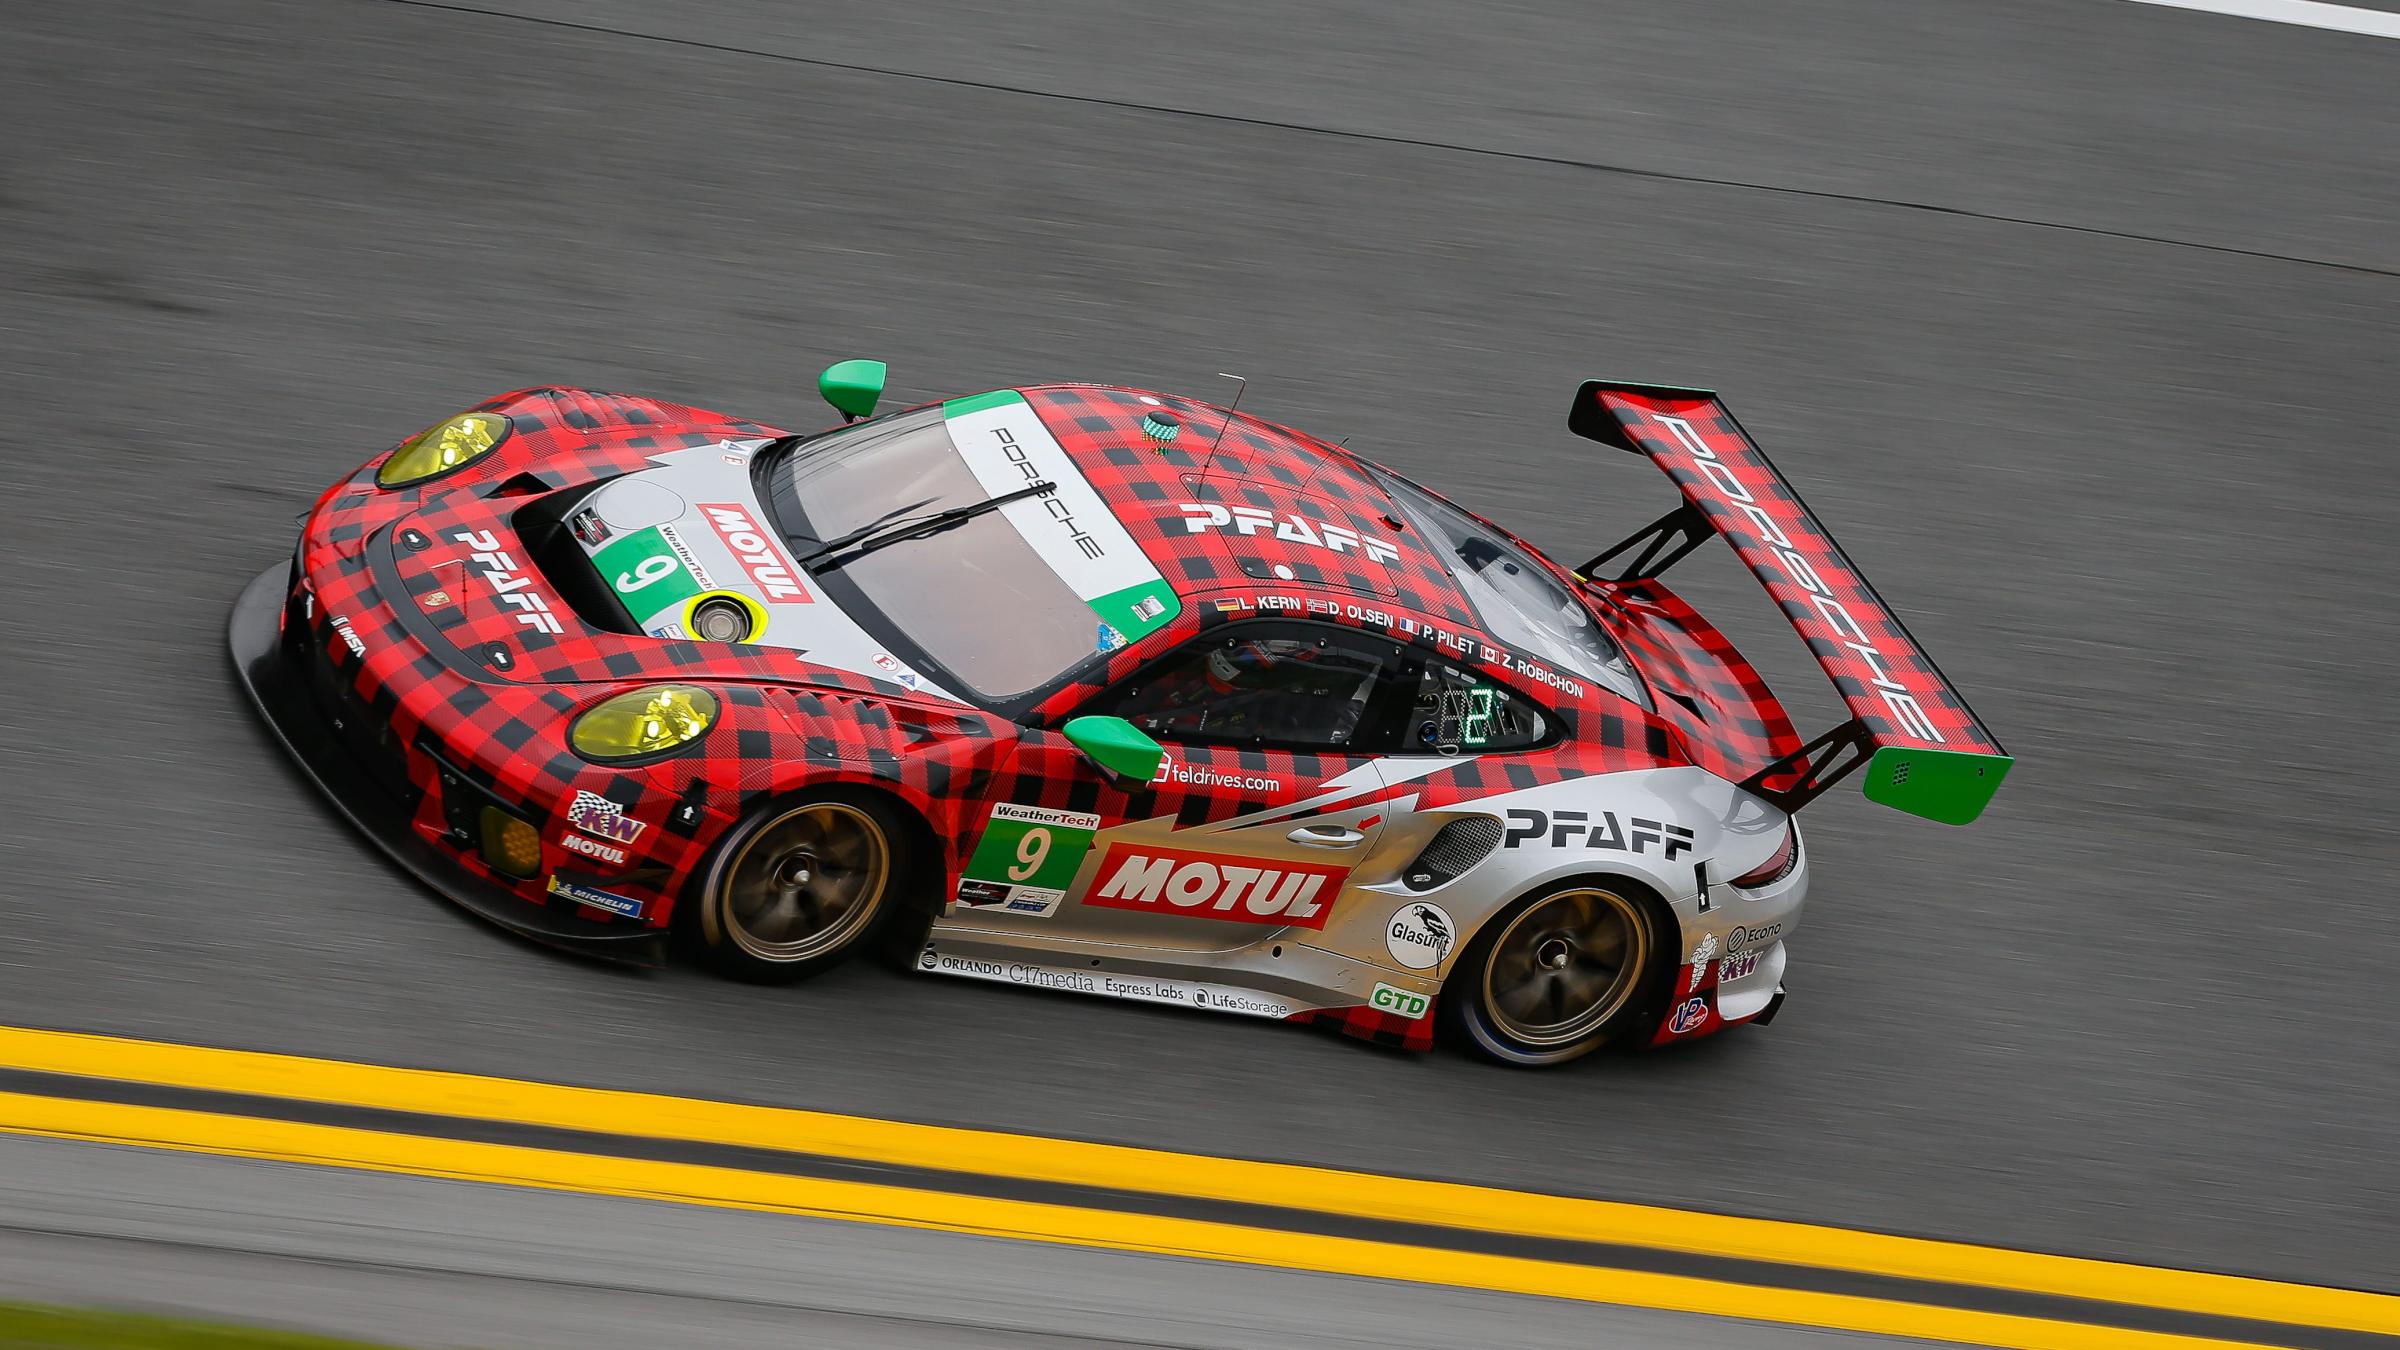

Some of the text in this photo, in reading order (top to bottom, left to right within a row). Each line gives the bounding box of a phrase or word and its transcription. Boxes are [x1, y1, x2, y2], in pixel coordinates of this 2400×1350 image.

[1181, 503, 1399, 564] PFAFF
[662, 526, 713, 589] WeatherTech
[706, 507, 802, 598] MOTUL
[455, 529, 564, 634] PFAFF
[616, 555, 679, 593] 9
[1653, 414, 1946, 743] PORSCHE
[1241, 596, 1301, 611] L. KERN
[1329, 603, 1394, 629] D. OLSEN
[338, 626, 367, 658] IMSA
[1424, 625, 1475, 655] P. PILET
[1502, 654, 1584, 699] Z. ROBICHON
[1172, 765, 1281, 792] feldrives.com
[580, 805, 645, 842] KW
[997, 805, 1098, 827] WeatherTech
[562, 835, 625, 864] MOTUL
[1504, 808, 1695, 861] PFAFF
[1008, 828, 1052, 881] 9
[574, 890, 633, 911] MICHELIN
[1098, 855, 1327, 917] MOTUL
[1392, 922, 1450, 952] Glasurit
[1747, 923, 1782, 943] Econo
[942, 957, 1002, 976] ORLANDO
[1009, 963, 1095, 993] C17media
[1723, 954, 1762, 981] KW
[1105, 977, 1184, 1000] Espress Labs
[1374, 988, 1426, 1014] GTD
[1212, 993, 1288, 1016] LifeStorage
